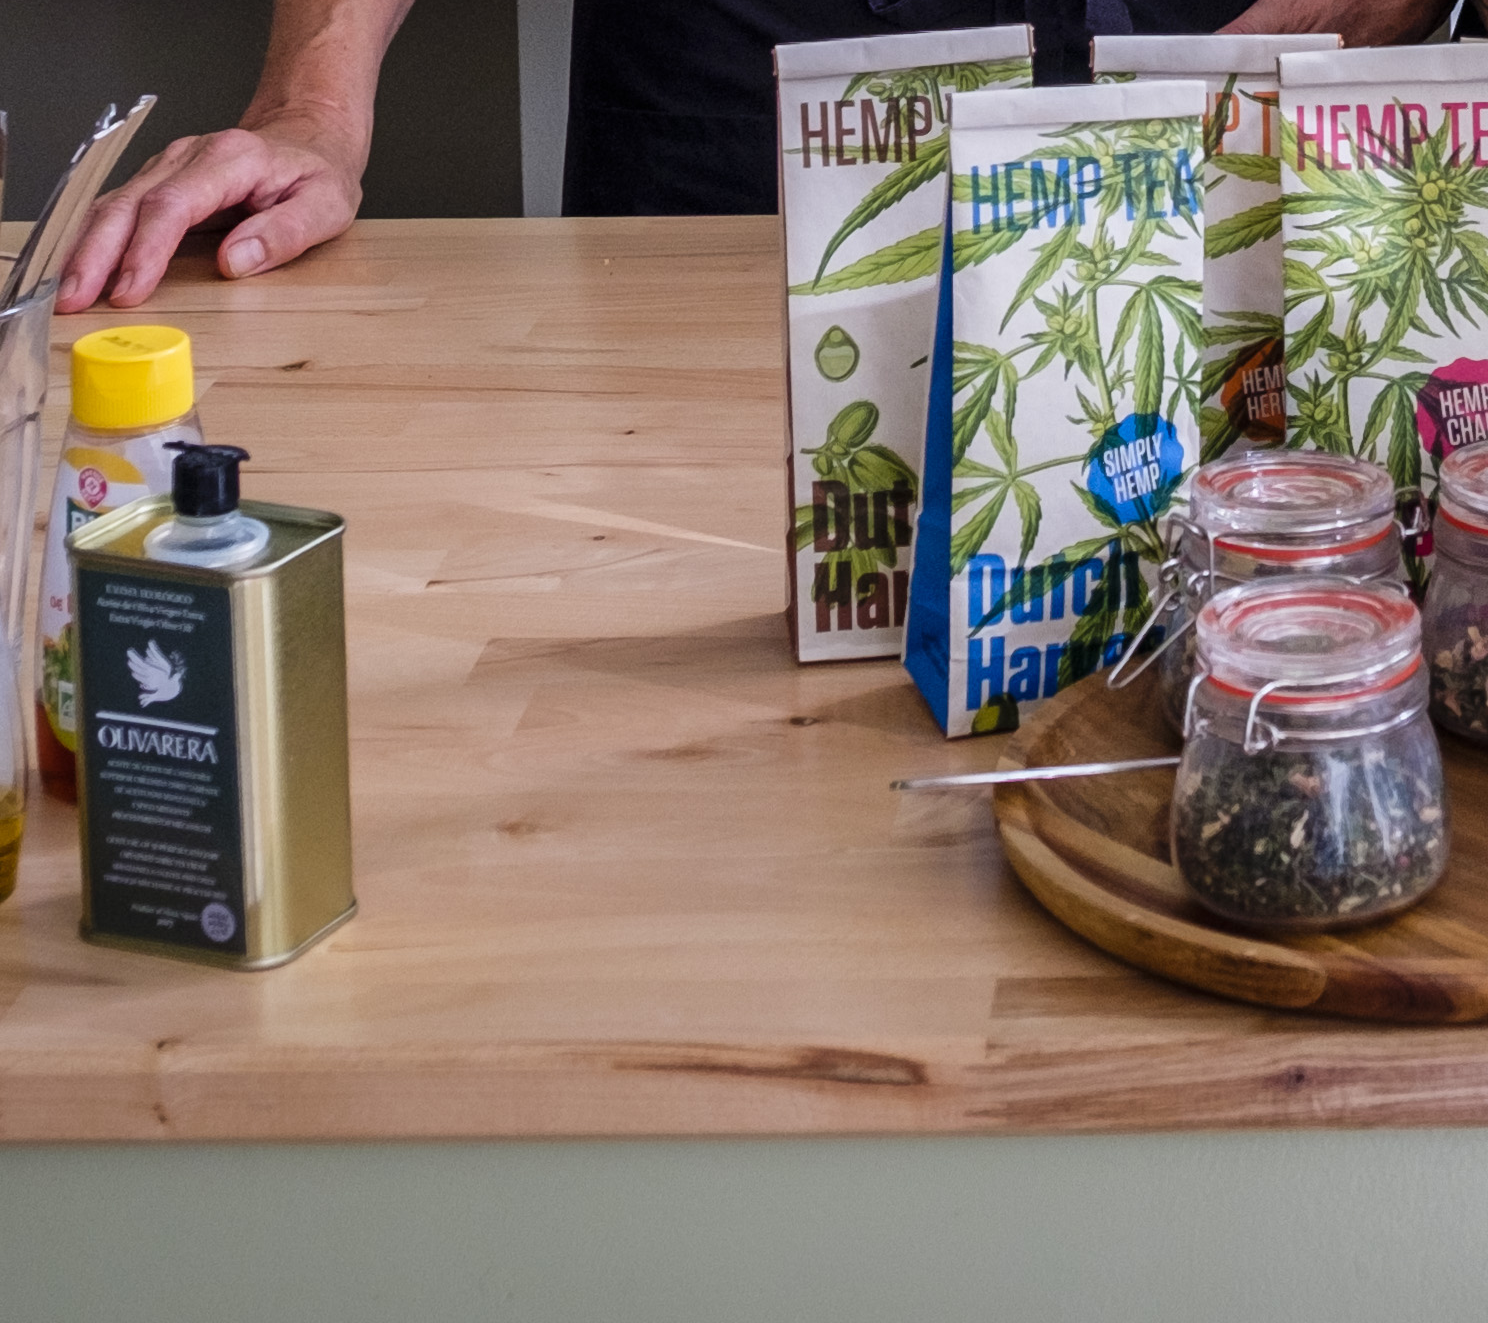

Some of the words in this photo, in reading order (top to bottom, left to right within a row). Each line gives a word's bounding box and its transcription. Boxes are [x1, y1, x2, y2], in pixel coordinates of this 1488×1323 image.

[800, 95, 932, 169] HEMP
[1296, 103, 1429, 171] HEMP
[971, 155, 1103, 235] HEMP
[1122, 148, 1199, 222] TEA
[1103, 432, 1164, 479] SIMPLY
[1114, 462, 1161, 504] HEMP
[967, 538, 1140, 628] Dutch
[97, 724, 220, 765] OLIVARERA
